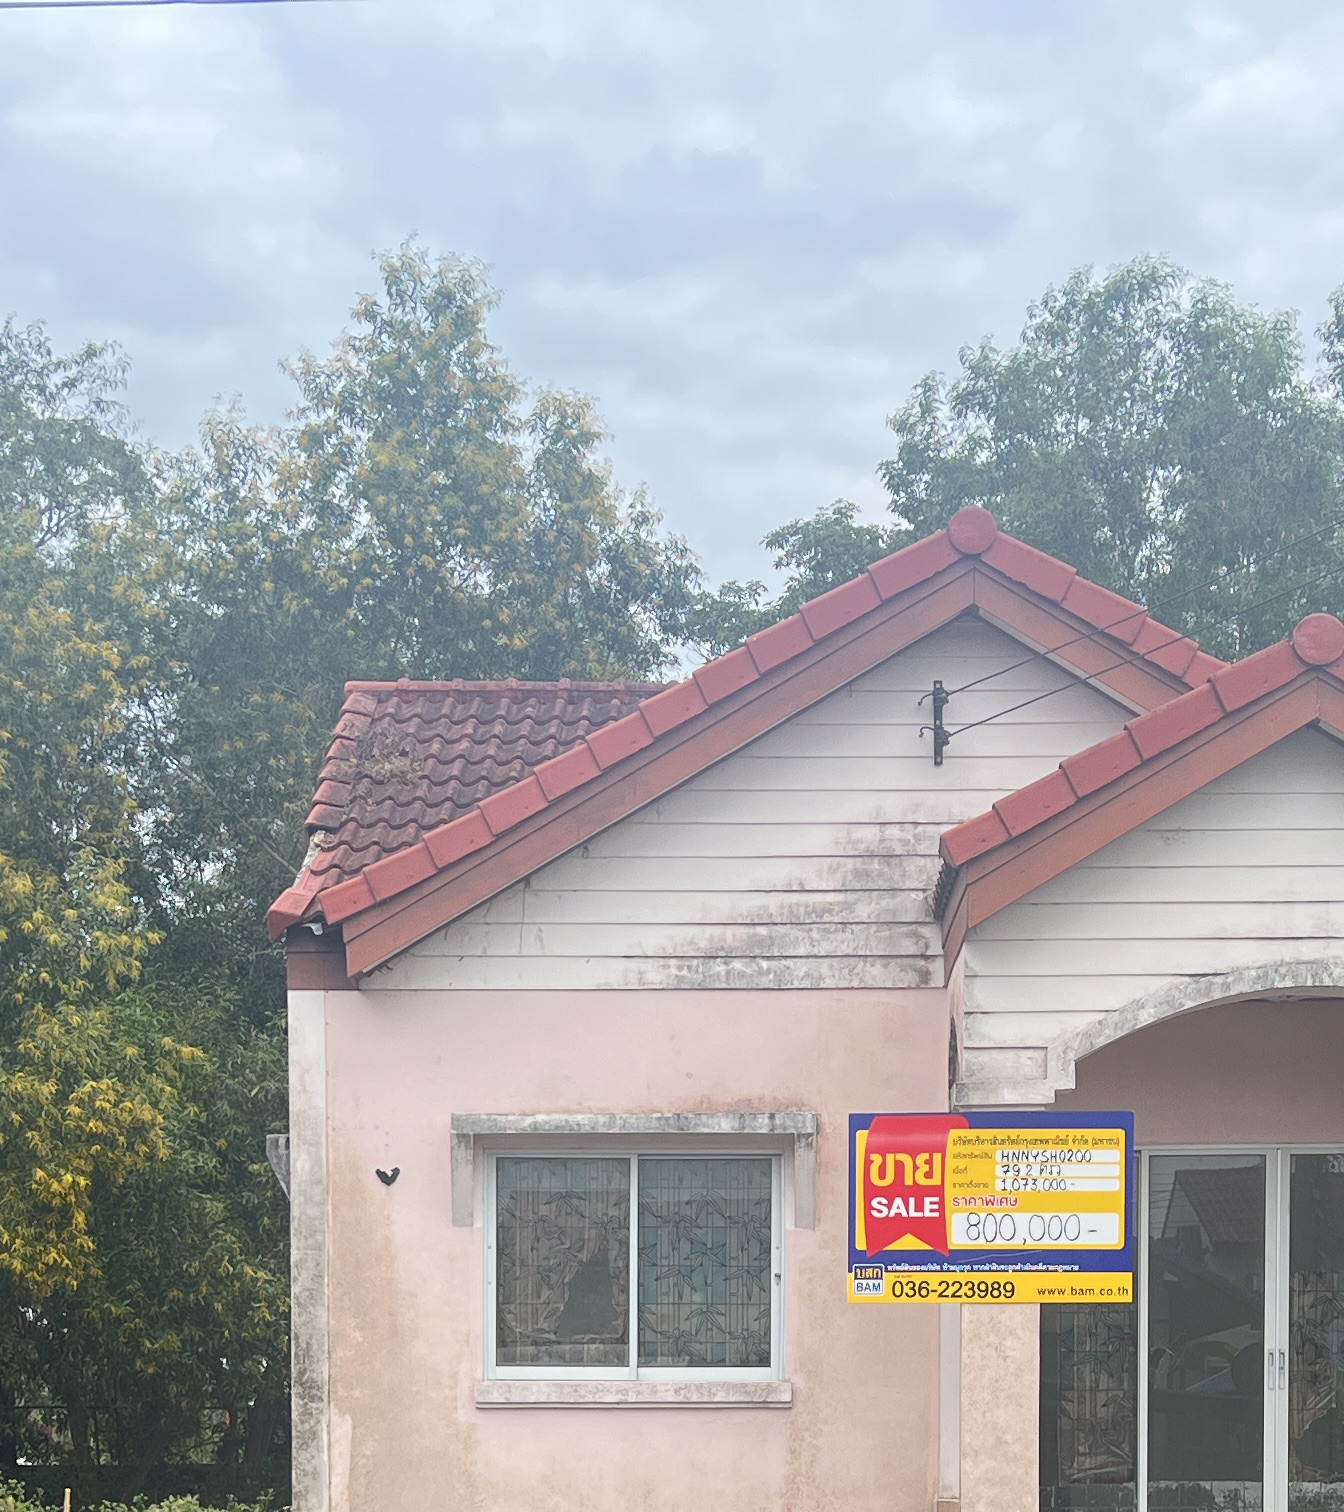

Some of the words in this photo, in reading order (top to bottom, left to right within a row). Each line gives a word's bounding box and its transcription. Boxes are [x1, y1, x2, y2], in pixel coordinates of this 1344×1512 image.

[869, 1152, 942, 1187] ขาย
[870, 1196, 940, 1219] SALE
[952, 1194, 1019, 1208] ราคาพิเศษ
[856, 1282, 881, 1292] BAM
[892, 1280, 1015, 1299] 036-223989
[1037, 1285, 1129, 1297] www.bam.co.th
